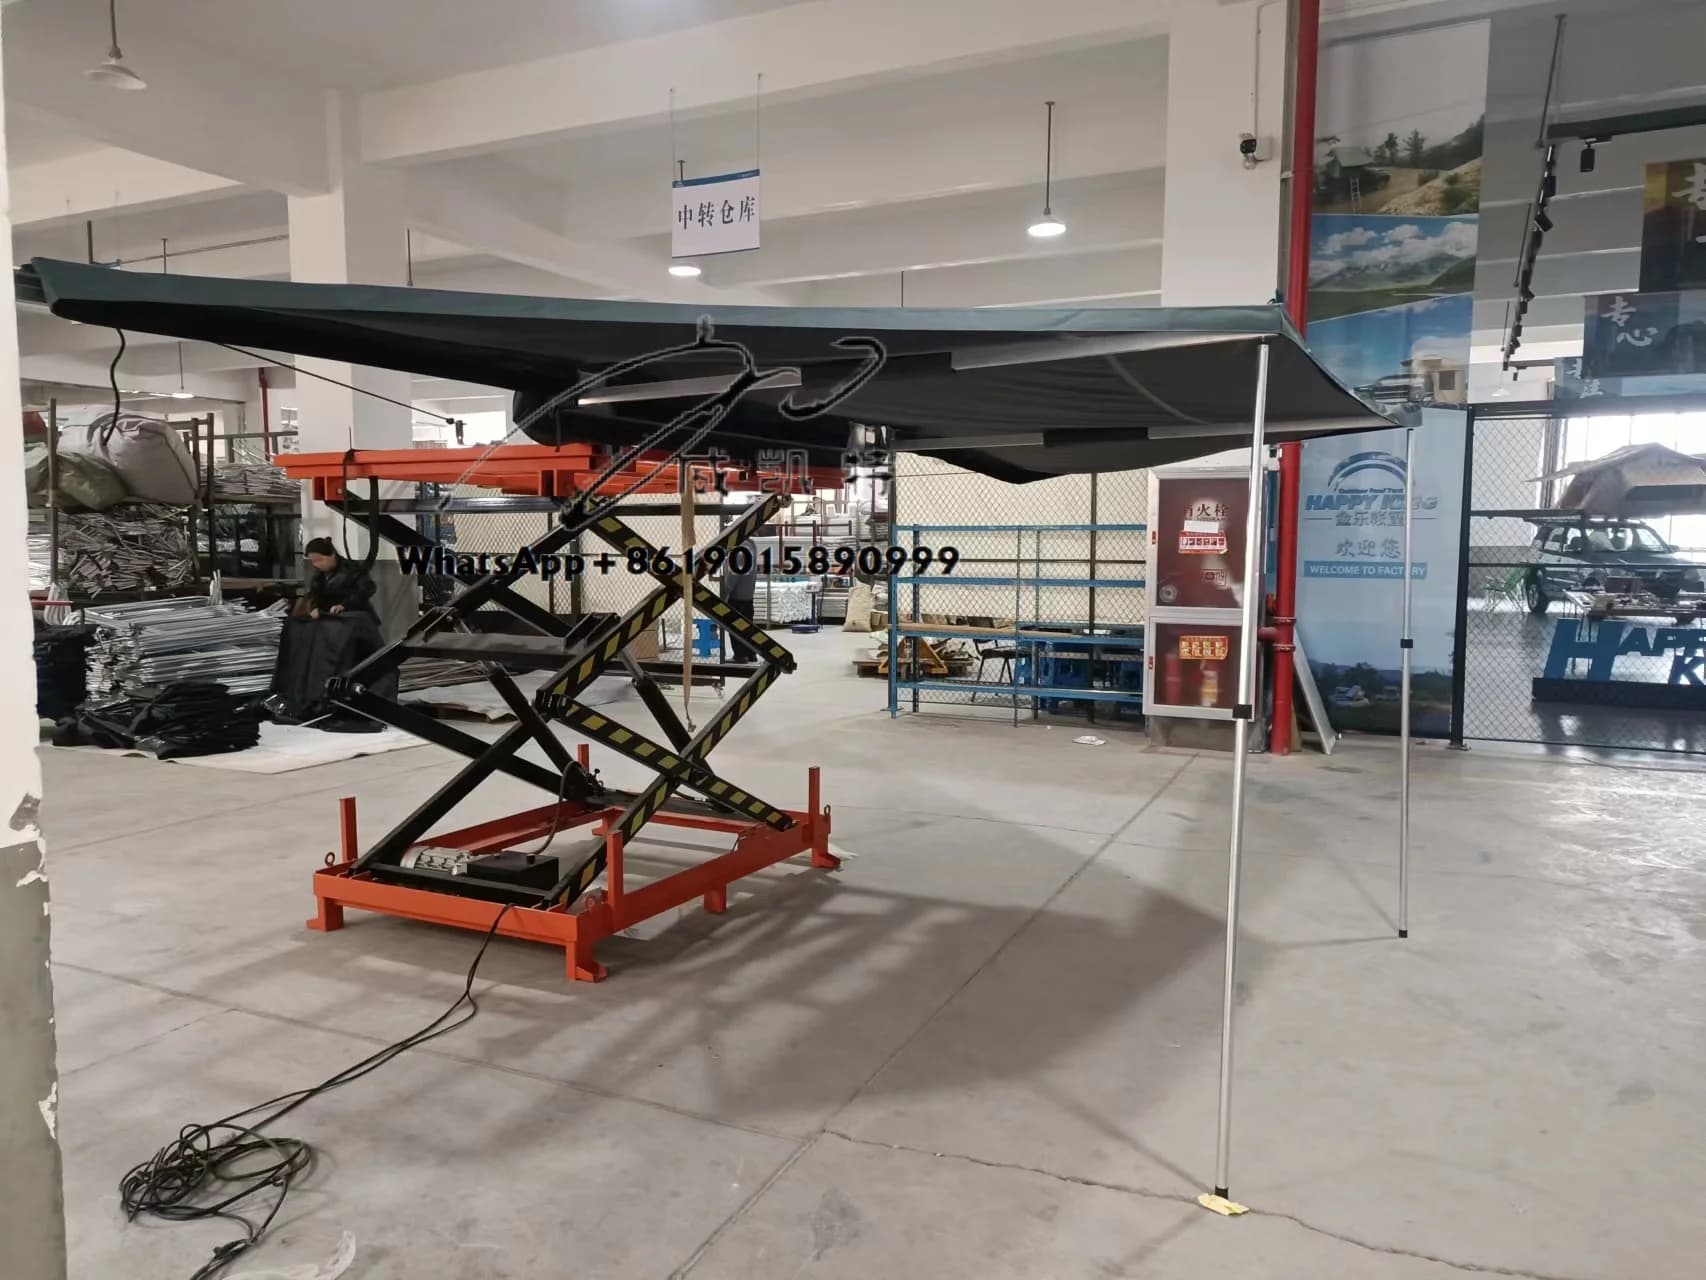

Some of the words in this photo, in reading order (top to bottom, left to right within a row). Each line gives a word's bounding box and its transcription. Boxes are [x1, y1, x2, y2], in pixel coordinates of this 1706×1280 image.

[678, 195, 755, 230] 中转仓库
[1305, 494, 1378, 511] HAPPY
[1336, 538, 1401, 559] 欢迎您
[1310, 565, 1360, 575] WELCOME
[1363, 565, 1376, 575] TO
[1379, 566, 1426, 575] FACTRY
